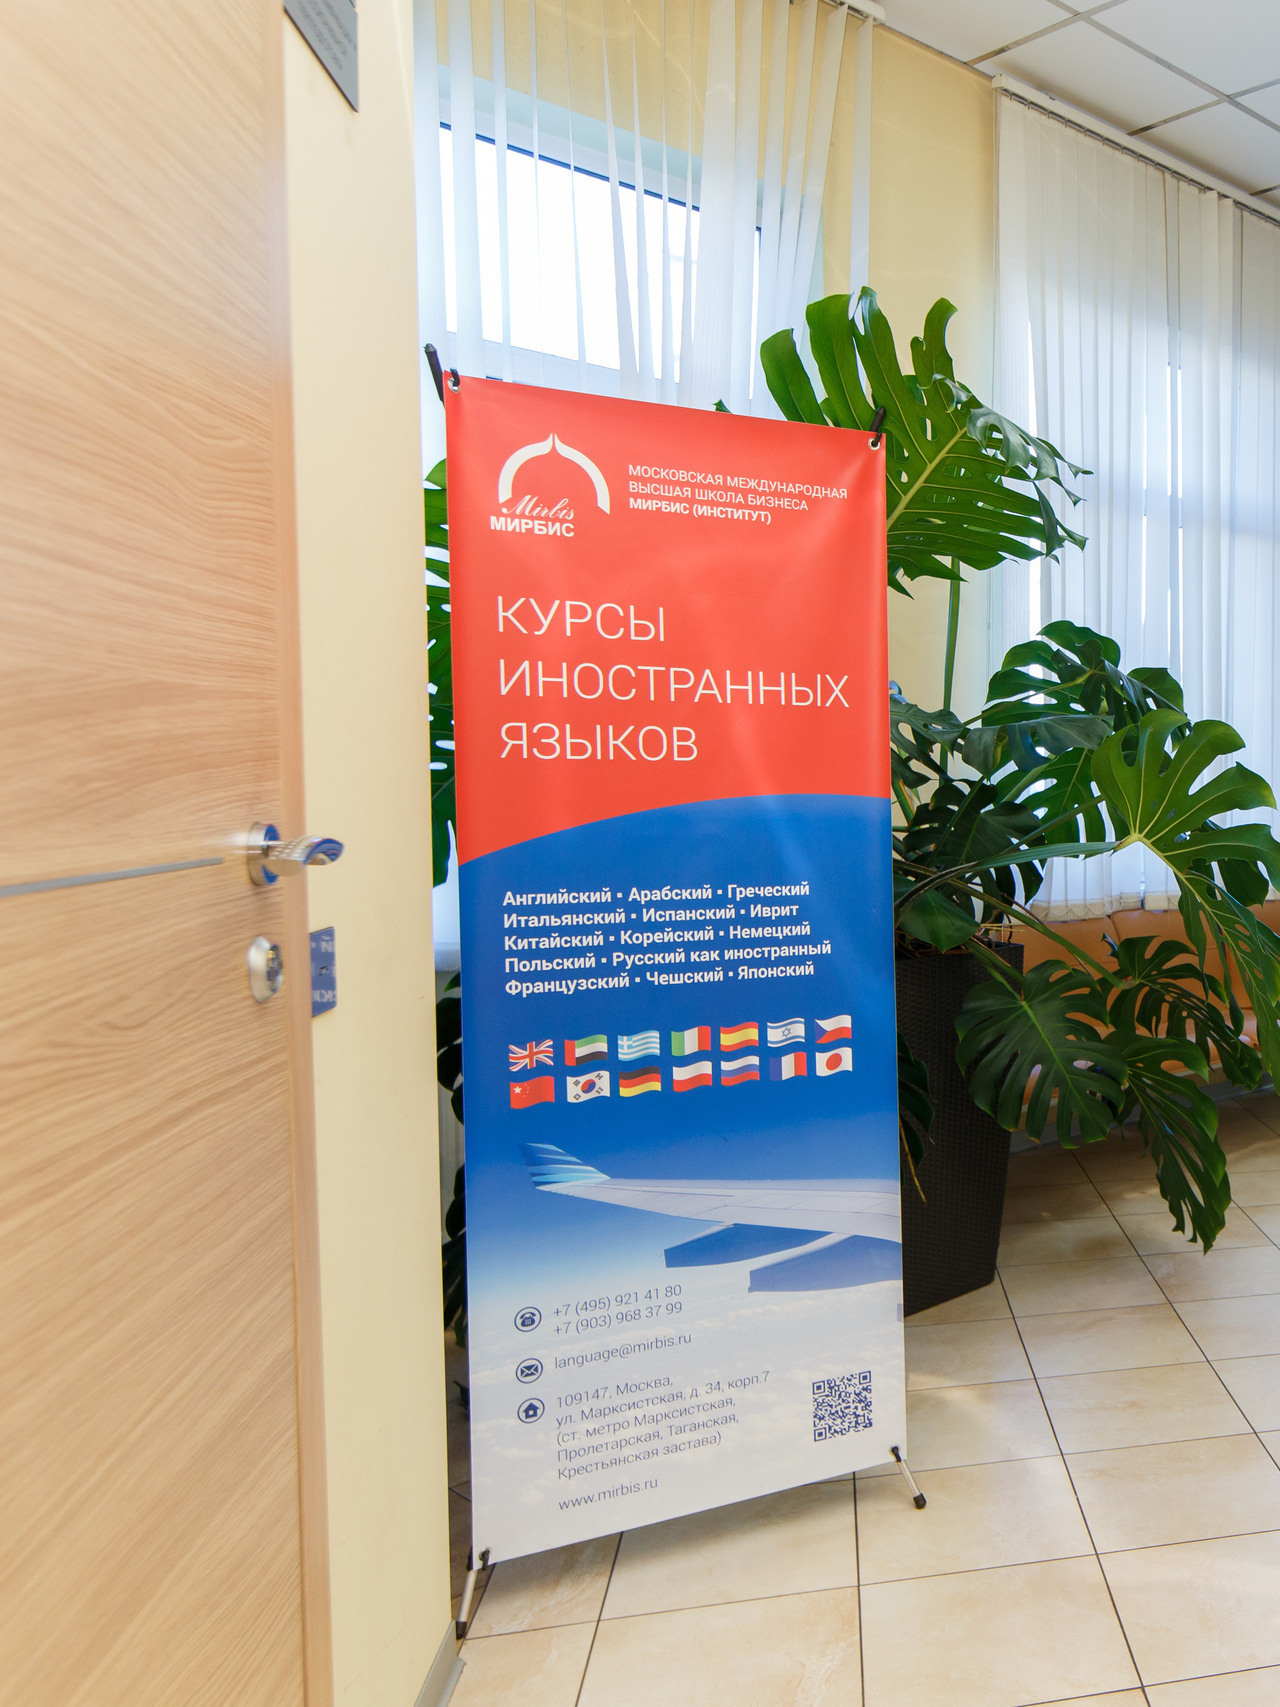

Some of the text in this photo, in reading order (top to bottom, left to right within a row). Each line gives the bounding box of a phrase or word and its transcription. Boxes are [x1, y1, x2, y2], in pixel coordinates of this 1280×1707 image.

[628, 464, 848, 499] МОСКОВСКАЯ МЕЖДУНАРОДНАЯ
[629, 481, 809, 511] ВЫСШАЯ ШКОЛА БИЗНЕСА
[502, 494, 575, 521] Mirbis
[629, 498, 772, 525] МИРБИС (ИНСТИТУТ)
[489, 515, 575, 538] МИРБИС
[496, 595, 665, 643] КУРСЫ
[499, 659, 850, 708] ИНОСТРАННЫХ
[500, 722, 698, 761] ЯЗЫКОВ
[502, 881, 811, 909] Английский Арабский Греческий
[503, 903, 800, 929] Итальянский Испанский Иврит
[504, 922, 811, 951] Китайский Корейский Немецкий
[505, 940, 832, 973] Польский Русский как иностранный
[505, 961, 815, 998] Французский Чешский Японский
[553, 1284, 682, 1317] +7 (495) 921 41 80
[553, 1301, 683, 1335] +7 (903) 968 37 99
[554, 1334, 692, 1370] language@mirbis.ru
[556, 1376, 674, 1409] 109147, Москва,
[556, 1370, 770, 1430] ул. Марксистская, д. 34, корп.7
[556, 1397, 736, 1447] (ст. метро Марксистская,
[557, 1413, 739, 1463] Пролетарская, Таганская,
[557, 1431, 722, 1480] Крестьянская застава)
[558, 1478, 659, 1511] www.mirbis.ru
